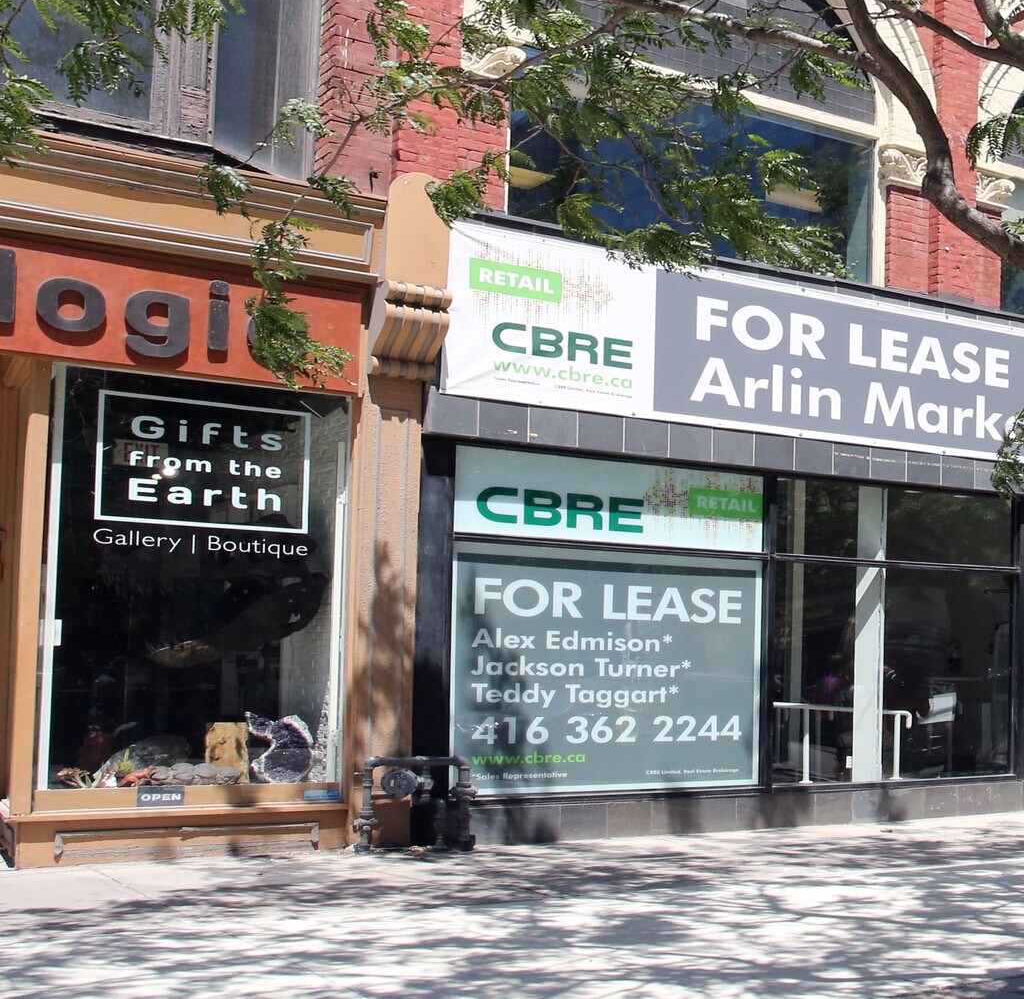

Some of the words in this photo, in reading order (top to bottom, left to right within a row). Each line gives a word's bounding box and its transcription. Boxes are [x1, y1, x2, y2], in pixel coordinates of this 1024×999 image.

[479, 266, 555, 295] RETAIL
[0, 249, 310, 368] logi
[492, 321, 634, 370] CBRE
[695, 295, 826, 361] FOR
[848, 322, 1010, 389] LEASE
[492, 359, 633, 390] www.cbre.ca
[690, 356, 842, 420] Arlin
[131, 415, 283, 452] Gifts
[129, 450, 212, 474] from
[229, 459, 282, 479] the
[128, 477, 282, 512] Earth
[476, 486, 645, 534] CBRE
[696, 495, 758, 513] RETAIL
[93, 528, 182, 553] Gallery
[208, 535, 309, 559] Boutique
[474, 577, 583, 619] FOR
[603, 584, 742, 624] LEASE
[471, 628, 536, 650] Alex
[471, 656, 584, 677] Jackson
[471, 683, 555, 708] Teddy
[471, 716, 550, 745] 416
[566, 716, 637, 744] 362
[652, 714, 742, 742] 2244
[472, 751, 586, 765] www.cbre.ca
[503, 771, 568, 781] Representative
[140, 792, 182, 802] OPEN
